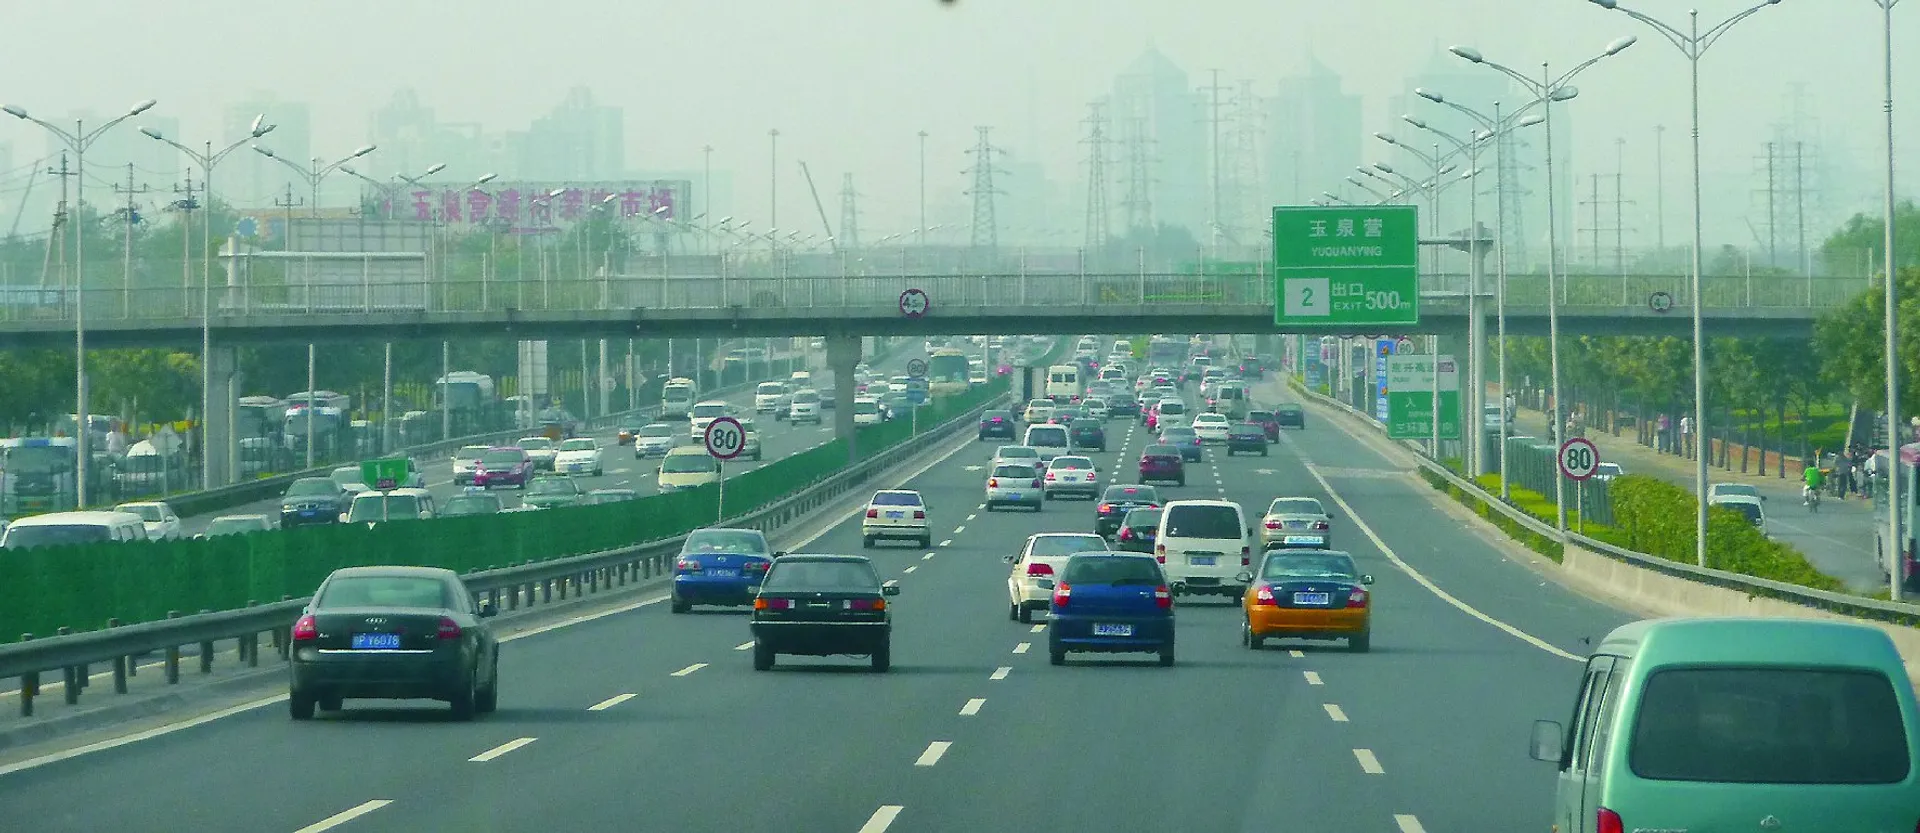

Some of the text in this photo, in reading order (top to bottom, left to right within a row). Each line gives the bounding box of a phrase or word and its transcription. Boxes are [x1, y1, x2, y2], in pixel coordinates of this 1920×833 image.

[1308, 217, 1383, 238] 玉泉营
[1311, 246, 1382, 257] YUQUANYING
[1300, 287, 1314, 307] 2
[1331, 282, 1364, 297] 出口
[1333, 301, 1362, 311] EXIT
[713, 428, 738, 450] 80
[1567, 447, 1591, 471] 80
